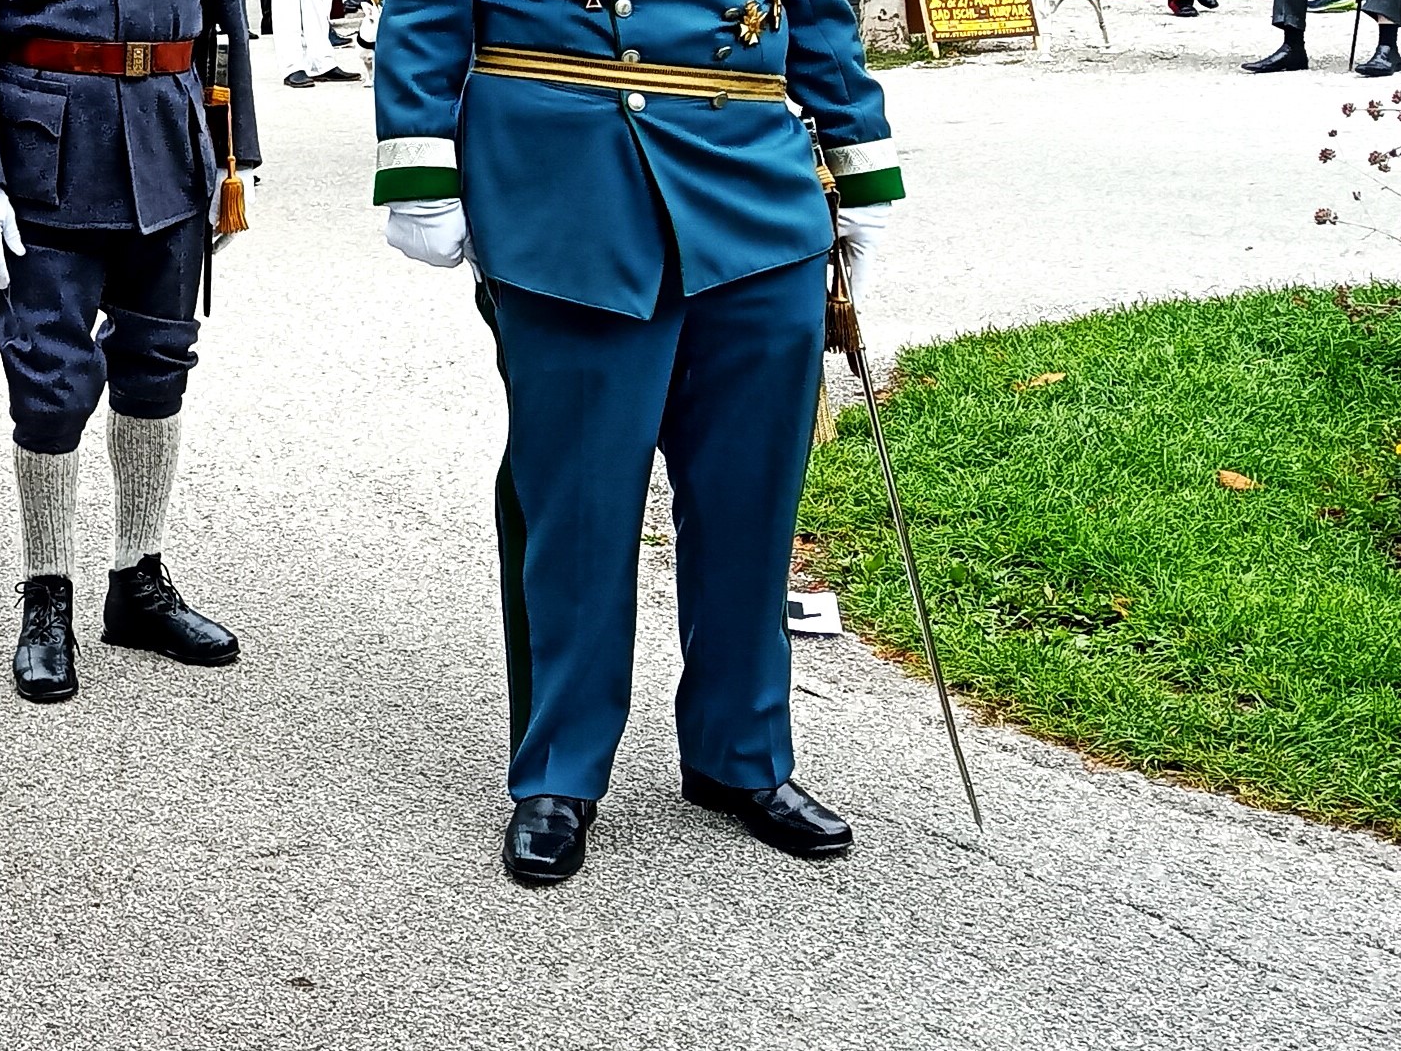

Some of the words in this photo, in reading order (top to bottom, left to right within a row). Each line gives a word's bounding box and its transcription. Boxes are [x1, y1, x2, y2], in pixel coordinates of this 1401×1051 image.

[931, 9, 950, 21] BAD
[952, 7, 979, 20] ISCHL
[989, 4, 1031, 18] KURPARK
